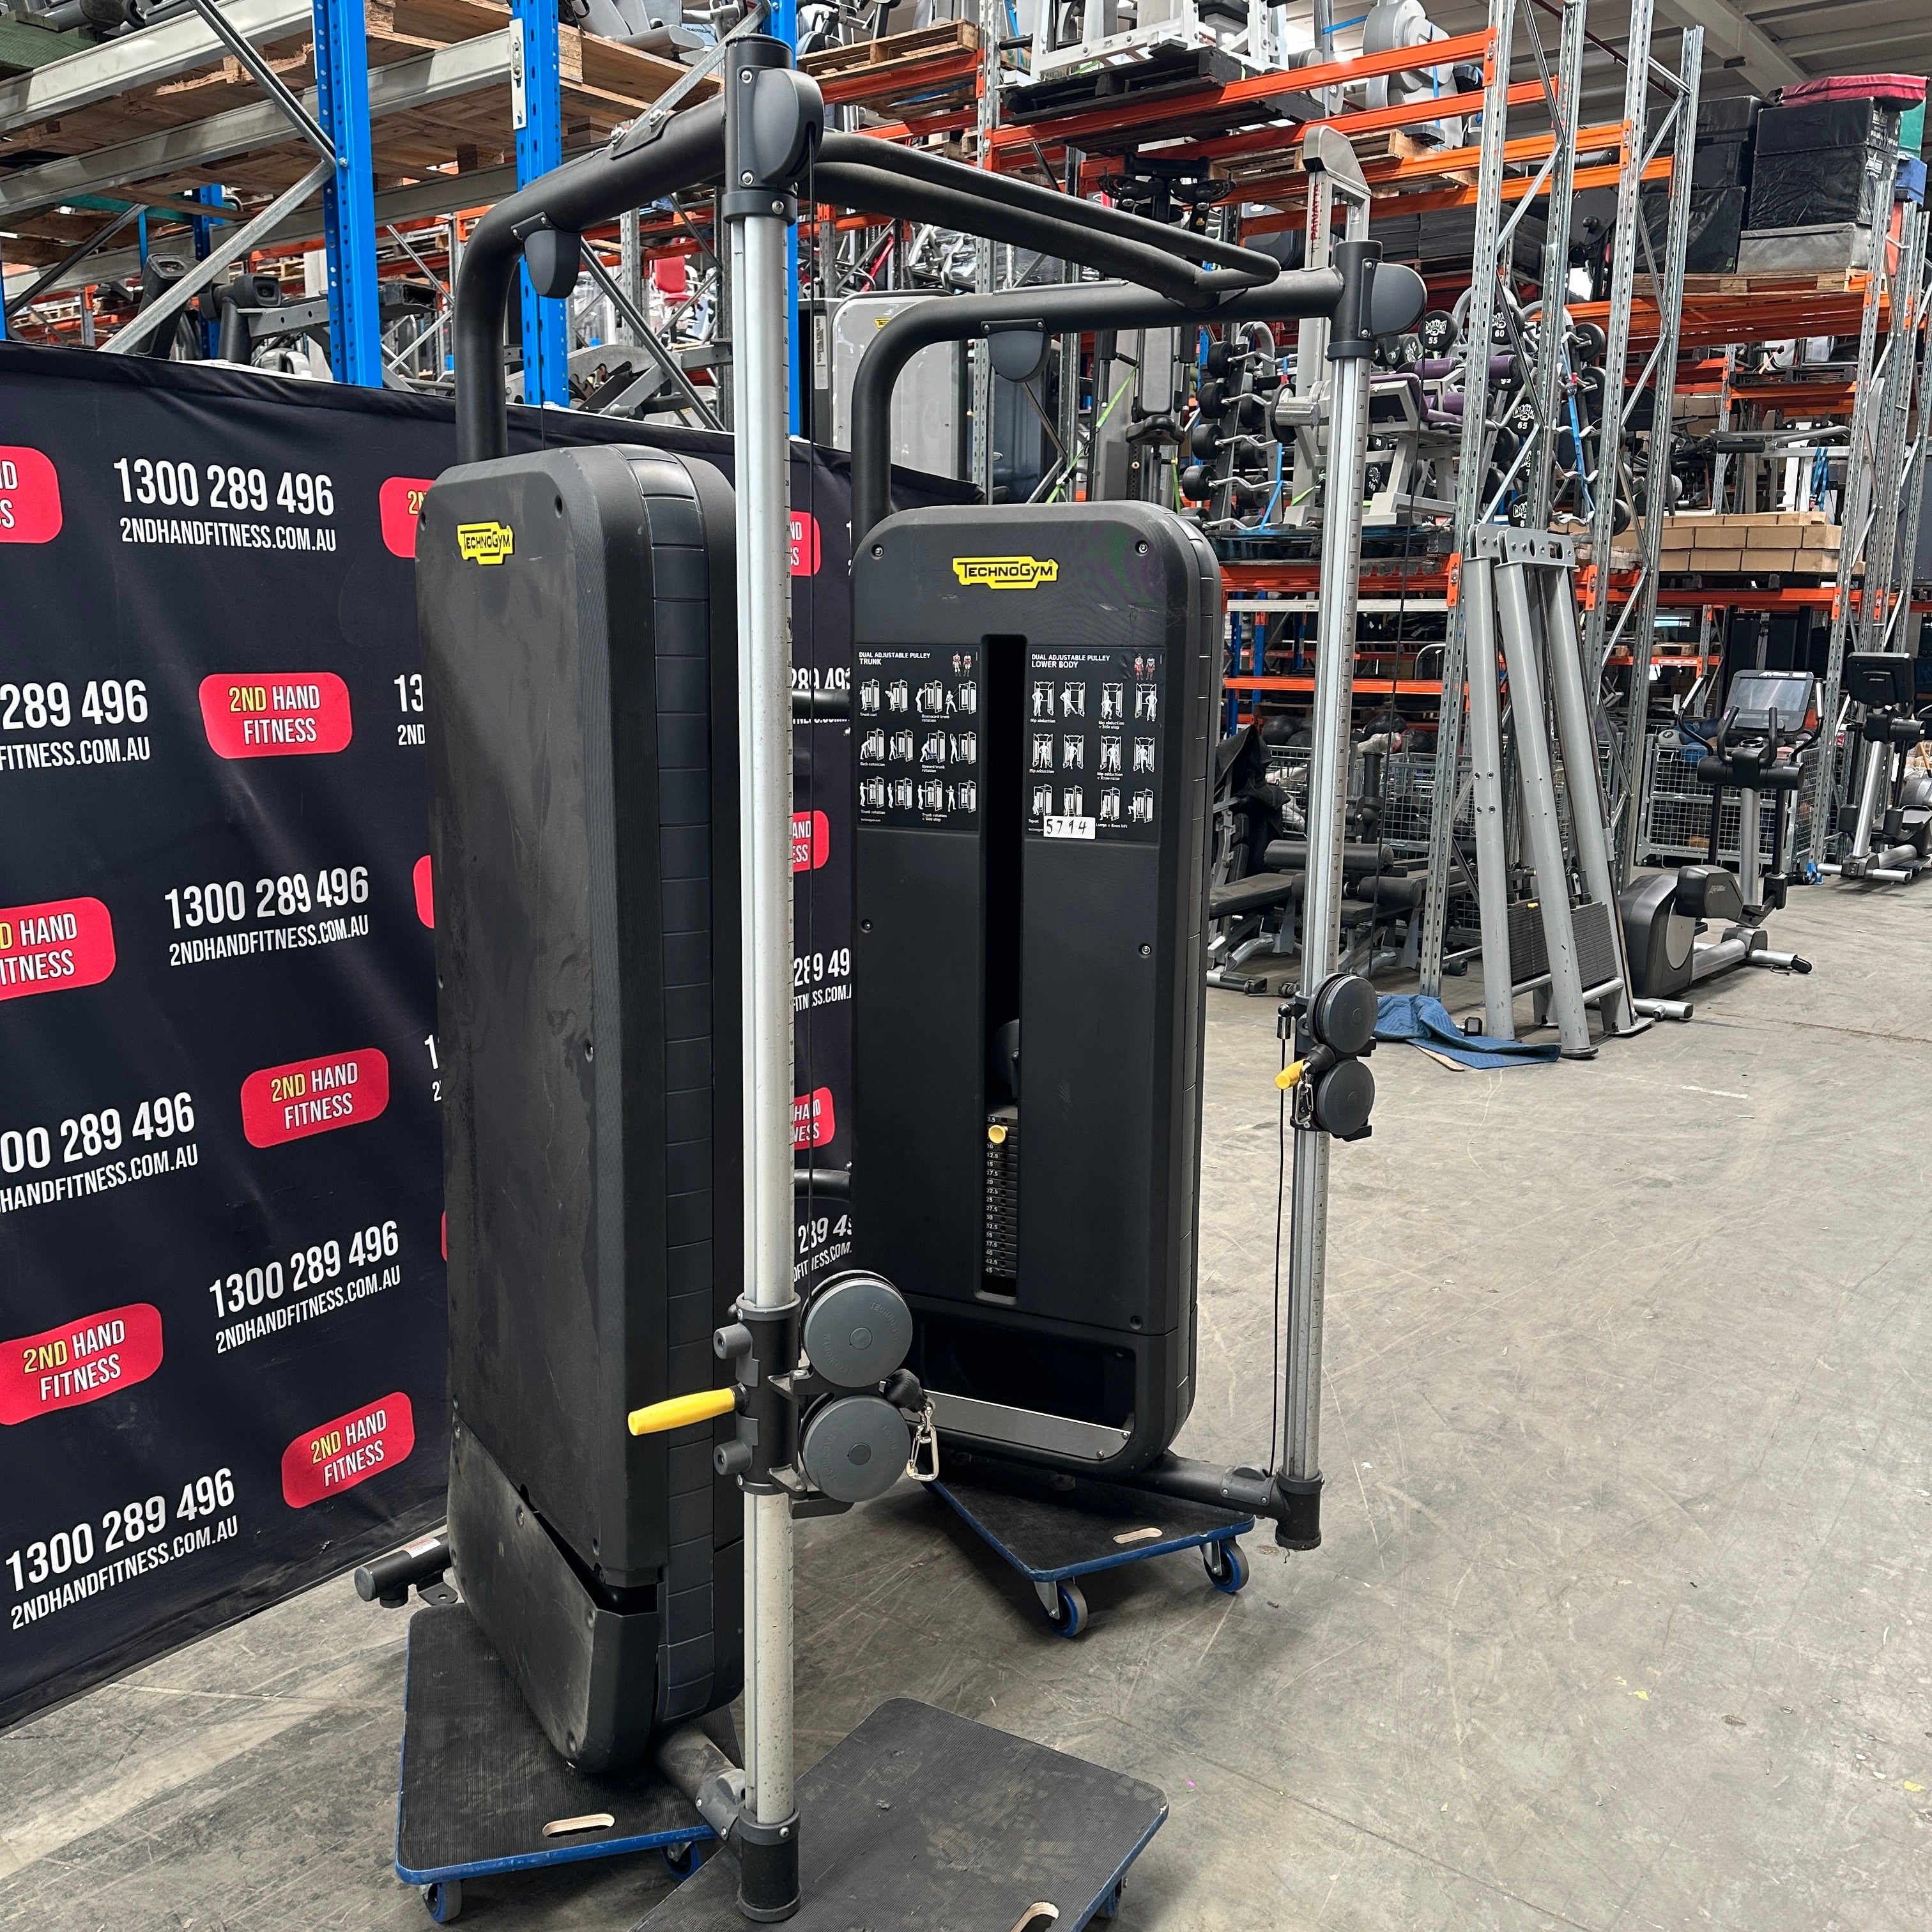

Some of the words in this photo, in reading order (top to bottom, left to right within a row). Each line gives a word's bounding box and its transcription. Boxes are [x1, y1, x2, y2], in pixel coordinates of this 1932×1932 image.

[114, 458, 199, 506] 1300
[207, 465, 268, 511] 289
[277, 472, 334, 516] 496
[120, 518, 336, 551] 2NDHANDFITNESS.COM.AU
[957, 560, 1053, 583] TECHNOGYM
[0, 682, 70, 730] 289
[82, 680, 148, 724] 496
[229, 687, 266, 712] 2ND
[273, 686, 319, 710] HAND
[244, 718, 316, 744] FITNESS
[165, 881, 245, 929] 1300
[256, 874, 311, 917] 289
[317, 866, 368, 907] 496
[20, 914, 77, 946] HAND
[169, 915, 368, 966] 2NDHANDFITNESS.COM.AU
[272, 1074, 305, 1101] 2ND
[312, 1062, 357, 1092] HAND
[61, 1109, 121, 1163] 289
[132, 1092, 194, 1140] 496
[285, 1093, 352, 1129] FITNESS
[210, 1262, 283, 1317] 1300
[291, 1241, 341, 1291] 289
[349, 1221, 398, 1266] 496
[216, 1266, 400, 1353] 2NDHANDFITNESS.COM.AU
[24, 1341, 67, 1373] 2ND
[72, 1320, 125, 1350] HAND
[41, 1354, 120, 1400] FITNESS
[311, 1431, 341, 1463] 2ND
[346, 1410, 386, 1446] HAND
[323, 1441, 384, 1486] FITNESS
[6, 1524, 93, 1591] 1300
[103, 1496, 165, 1552] 289
[177, 1468, 234, 1521] 496
[11, 1515, 237, 1630] 2NDHANDFITNESS.COM.AU
